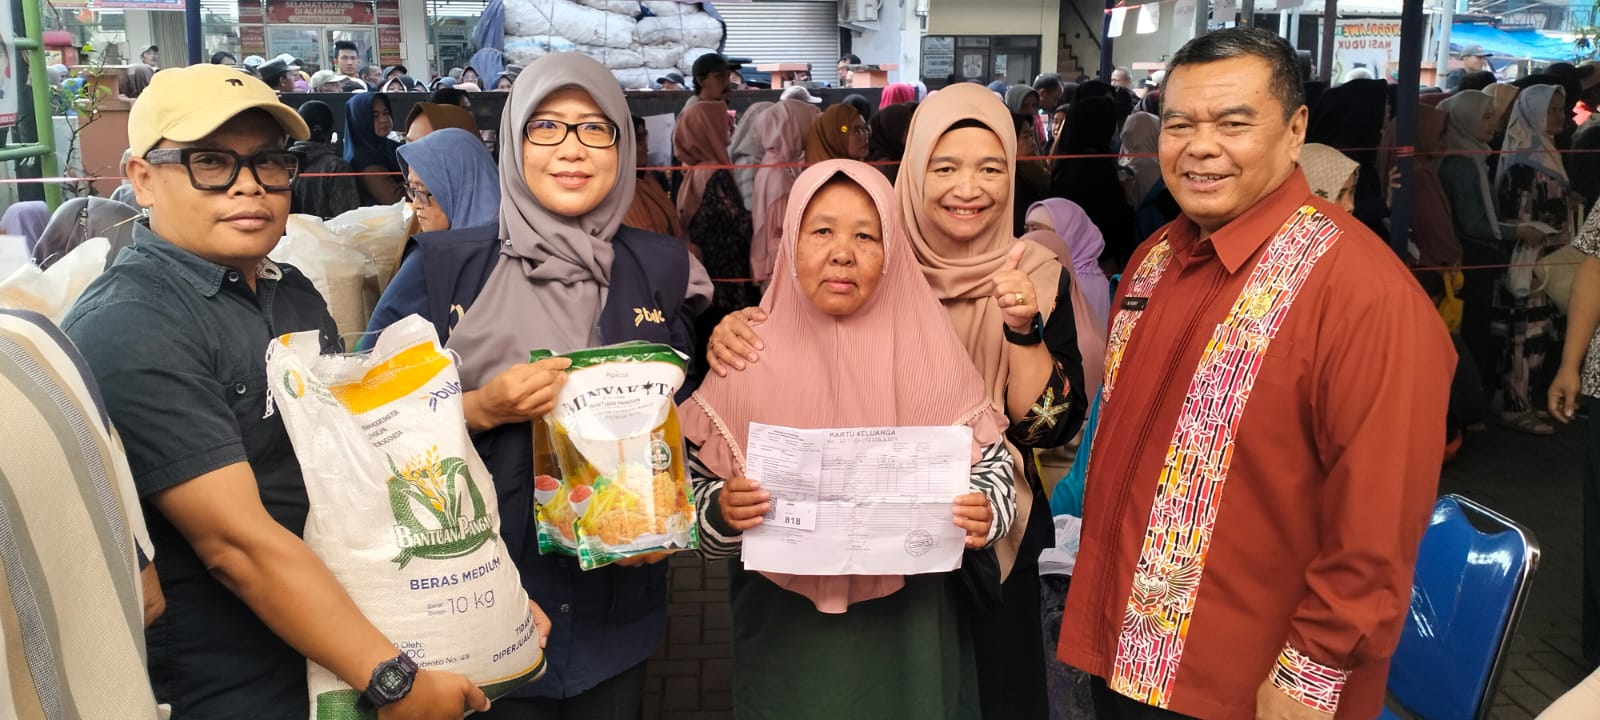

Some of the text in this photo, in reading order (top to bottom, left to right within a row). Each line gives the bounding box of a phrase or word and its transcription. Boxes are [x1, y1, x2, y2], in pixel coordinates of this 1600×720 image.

[285, 1, 354, 9] SELAMAT DATANG
[857, 429, 896, 437] KELUARGA
[784, 516, 801, 526] 818
[393, 525, 458, 548] BANTUAN
[410, 557, 501, 590] BERAS MEDIUM
[448, 588, 495, 615] 10 kg
